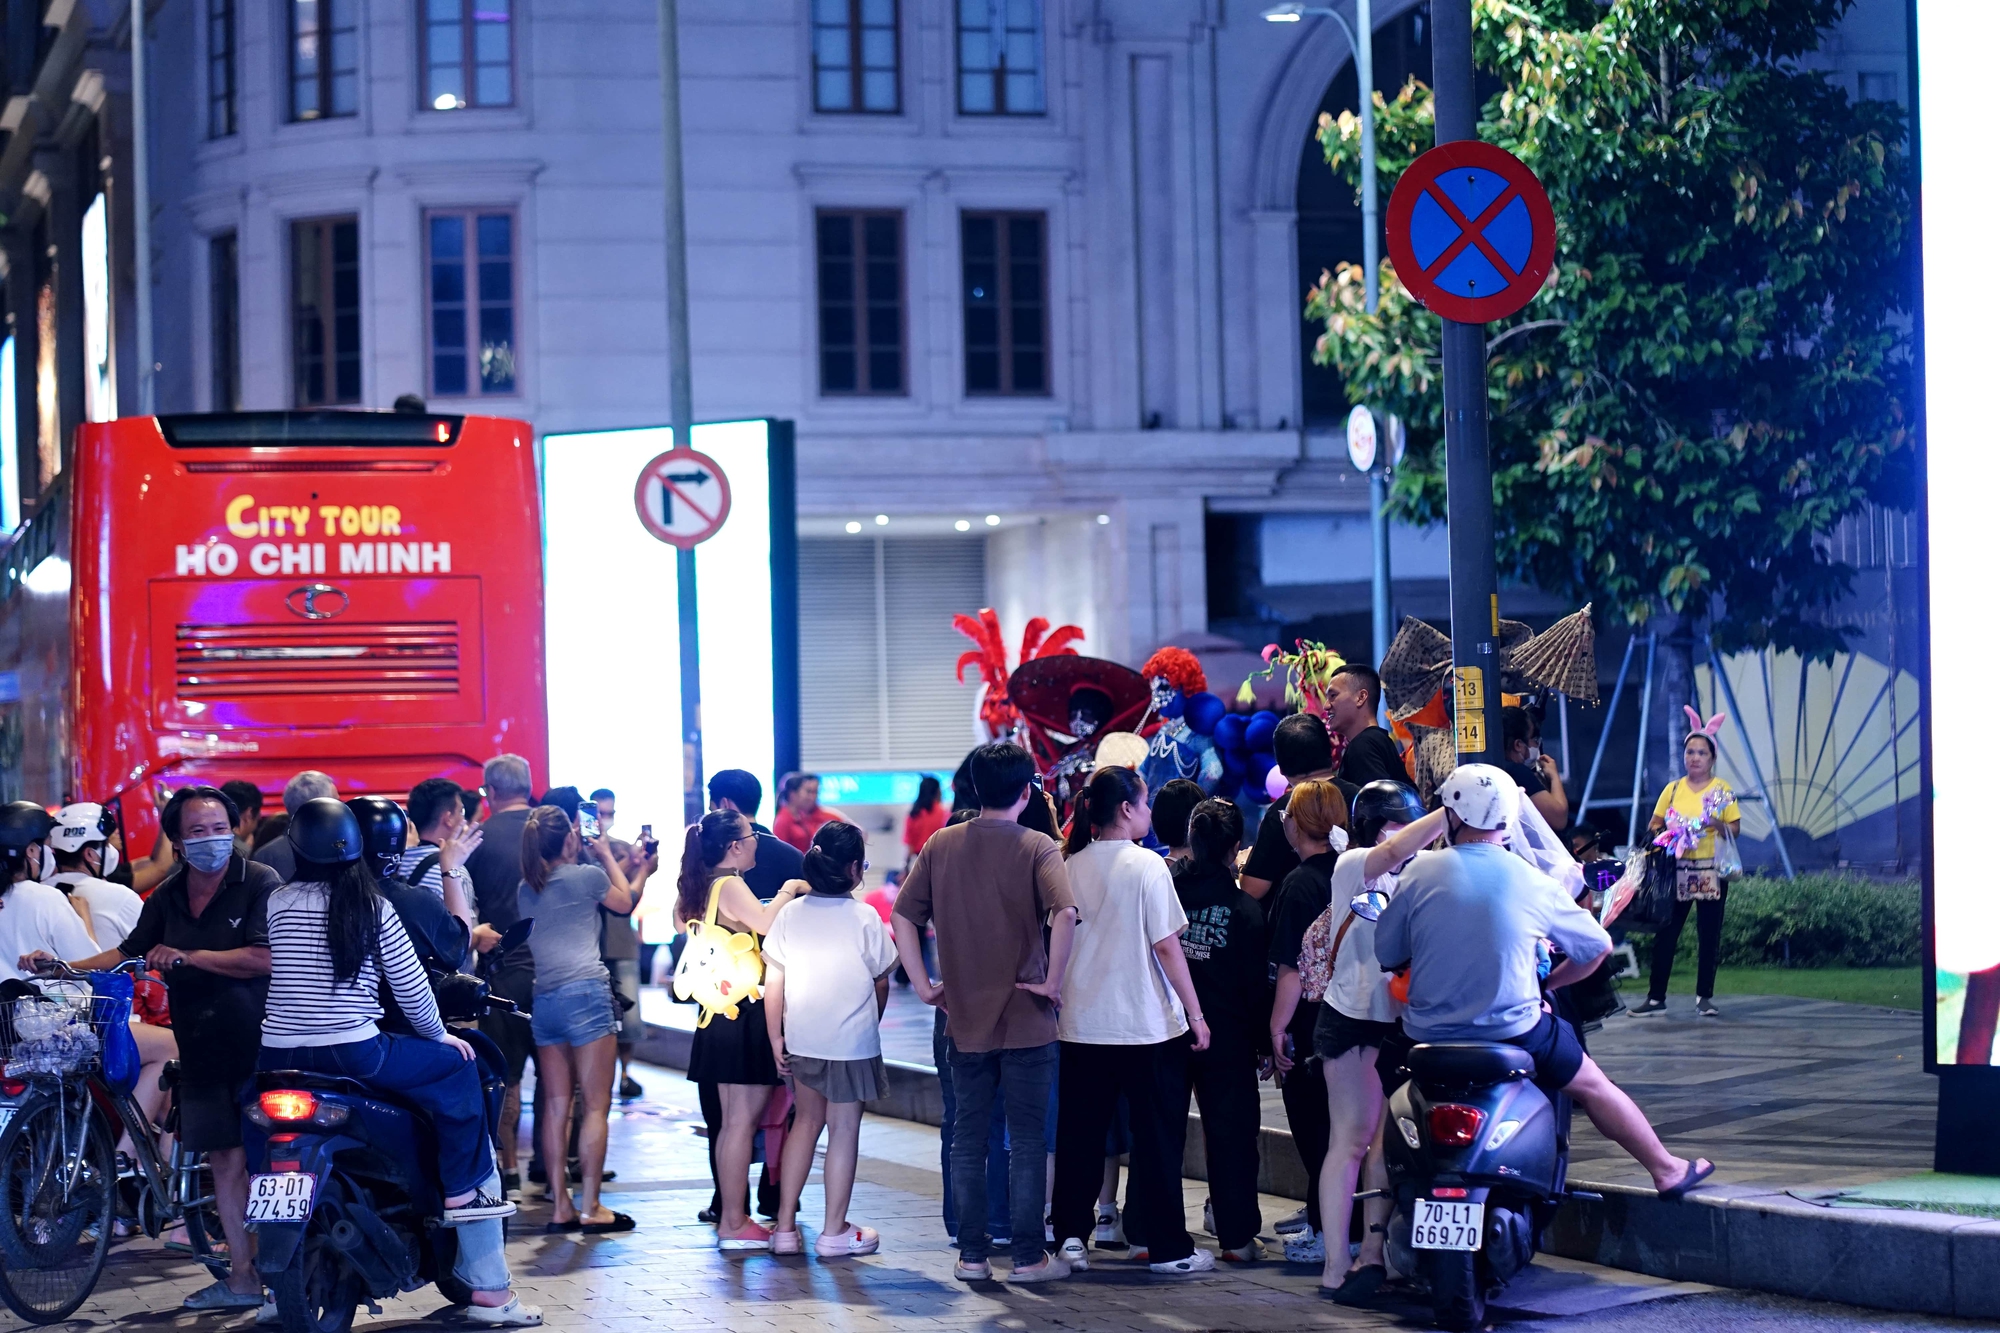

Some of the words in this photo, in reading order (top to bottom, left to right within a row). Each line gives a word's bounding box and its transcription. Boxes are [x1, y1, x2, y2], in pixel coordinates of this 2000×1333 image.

[319, 505, 401, 537] TOUR
[175, 543, 238, 576] HO
[250, 542, 326, 575] CHI
[339, 541, 451, 574] MINH
[258, 1177, 304, 1197] 63-D1
[248, 1199, 308, 1219] 274.59
[1424, 1203, 1470, 1225] 70-L1
[1415, 1225, 1477, 1247] 669.70
